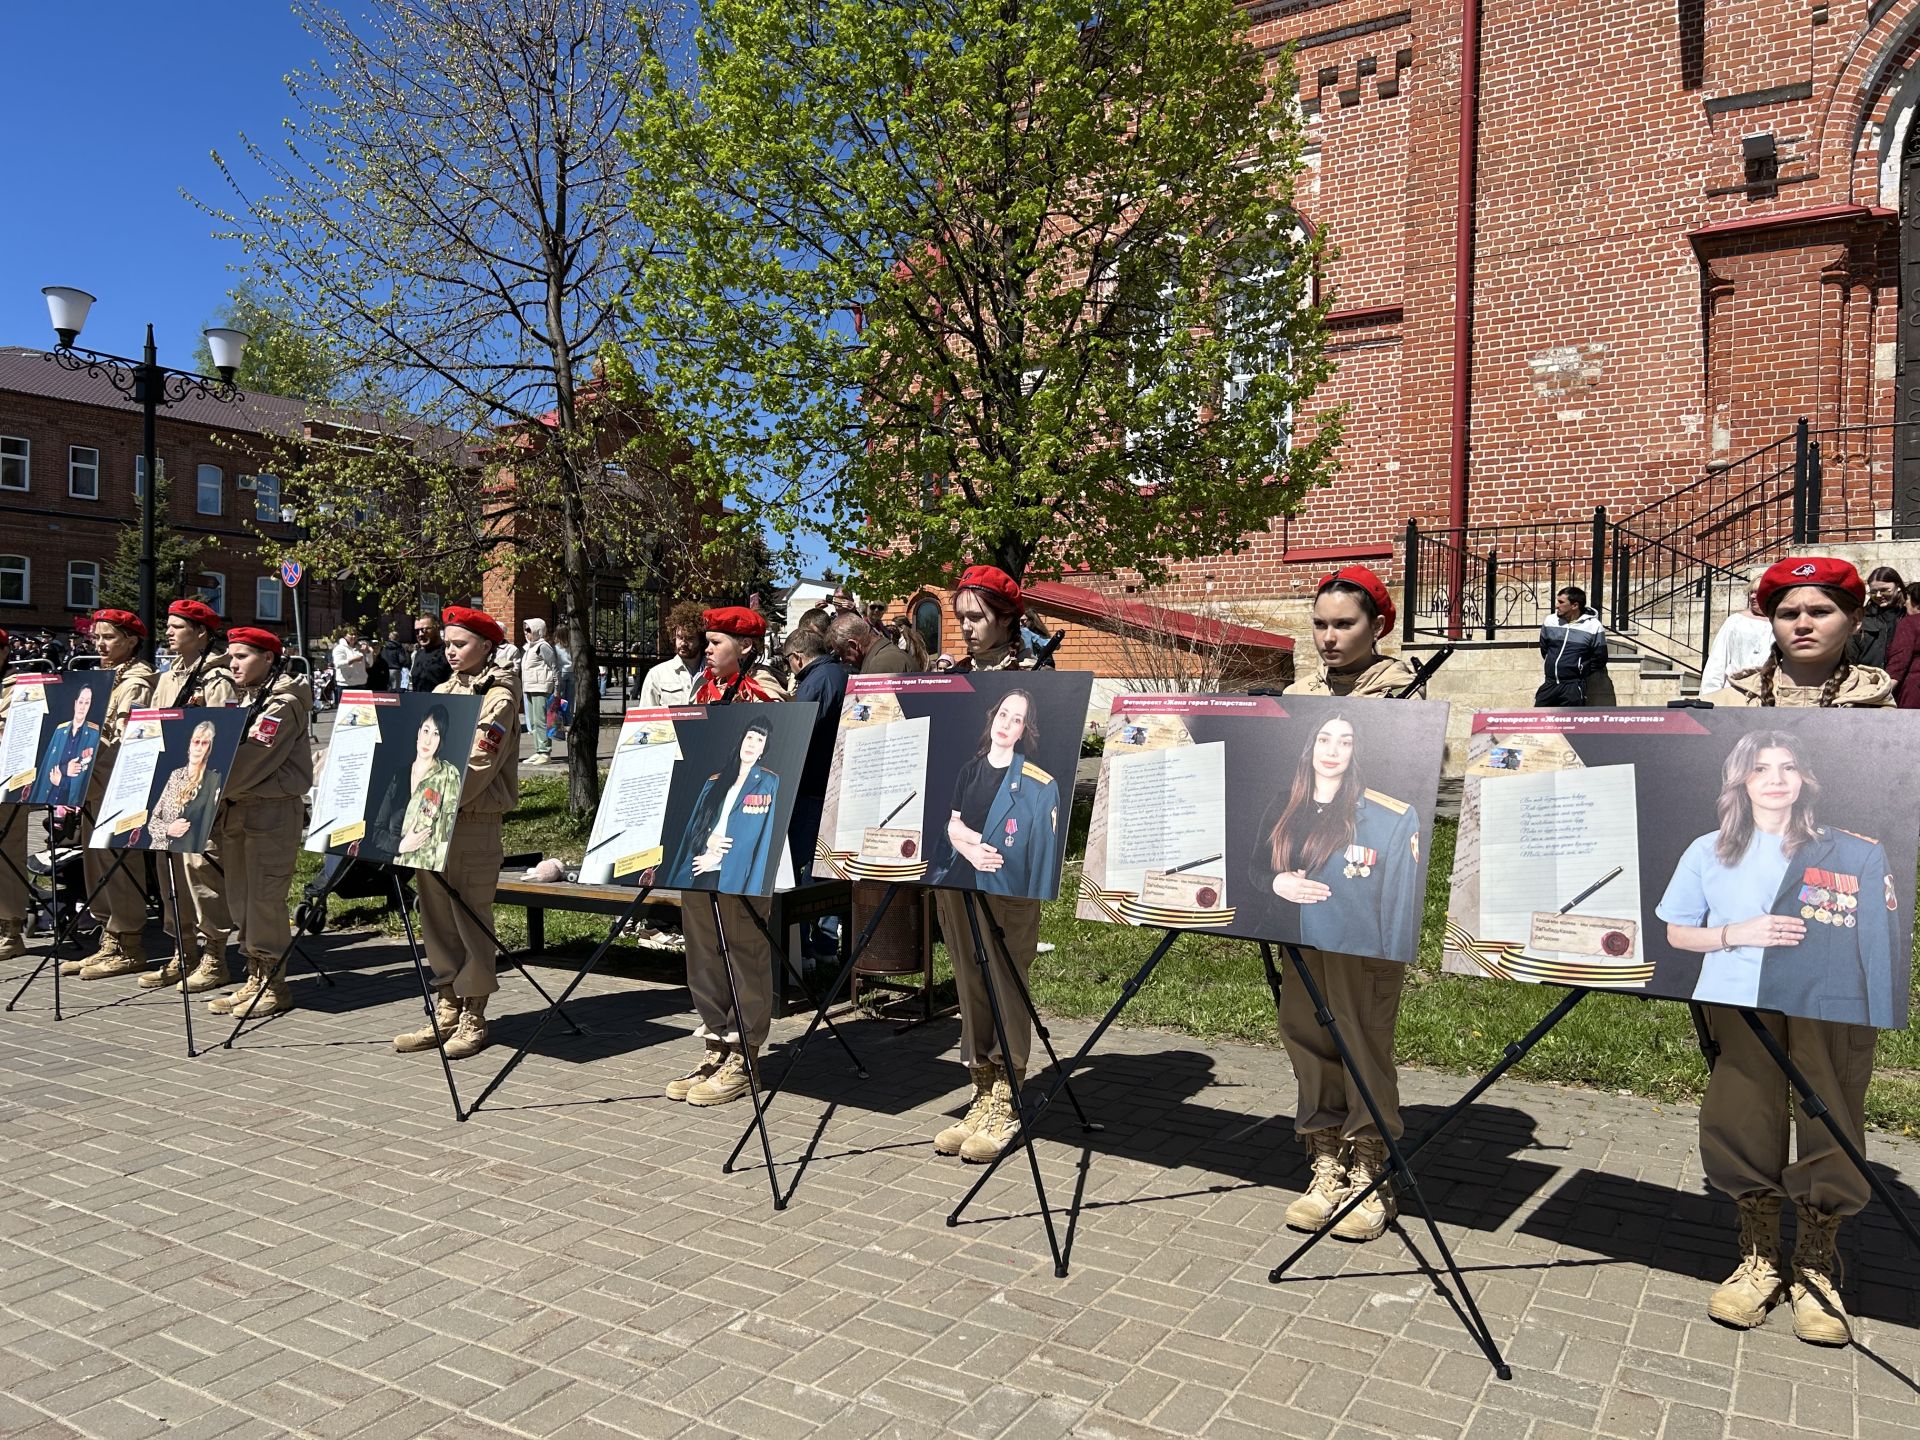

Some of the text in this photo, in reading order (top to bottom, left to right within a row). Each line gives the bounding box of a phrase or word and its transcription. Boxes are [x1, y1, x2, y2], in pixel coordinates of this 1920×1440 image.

[1210, 699, 1256, 707] Татарстана»
[1487, 715, 1665, 724] Фотопроект «Жена героя Татарстана»
